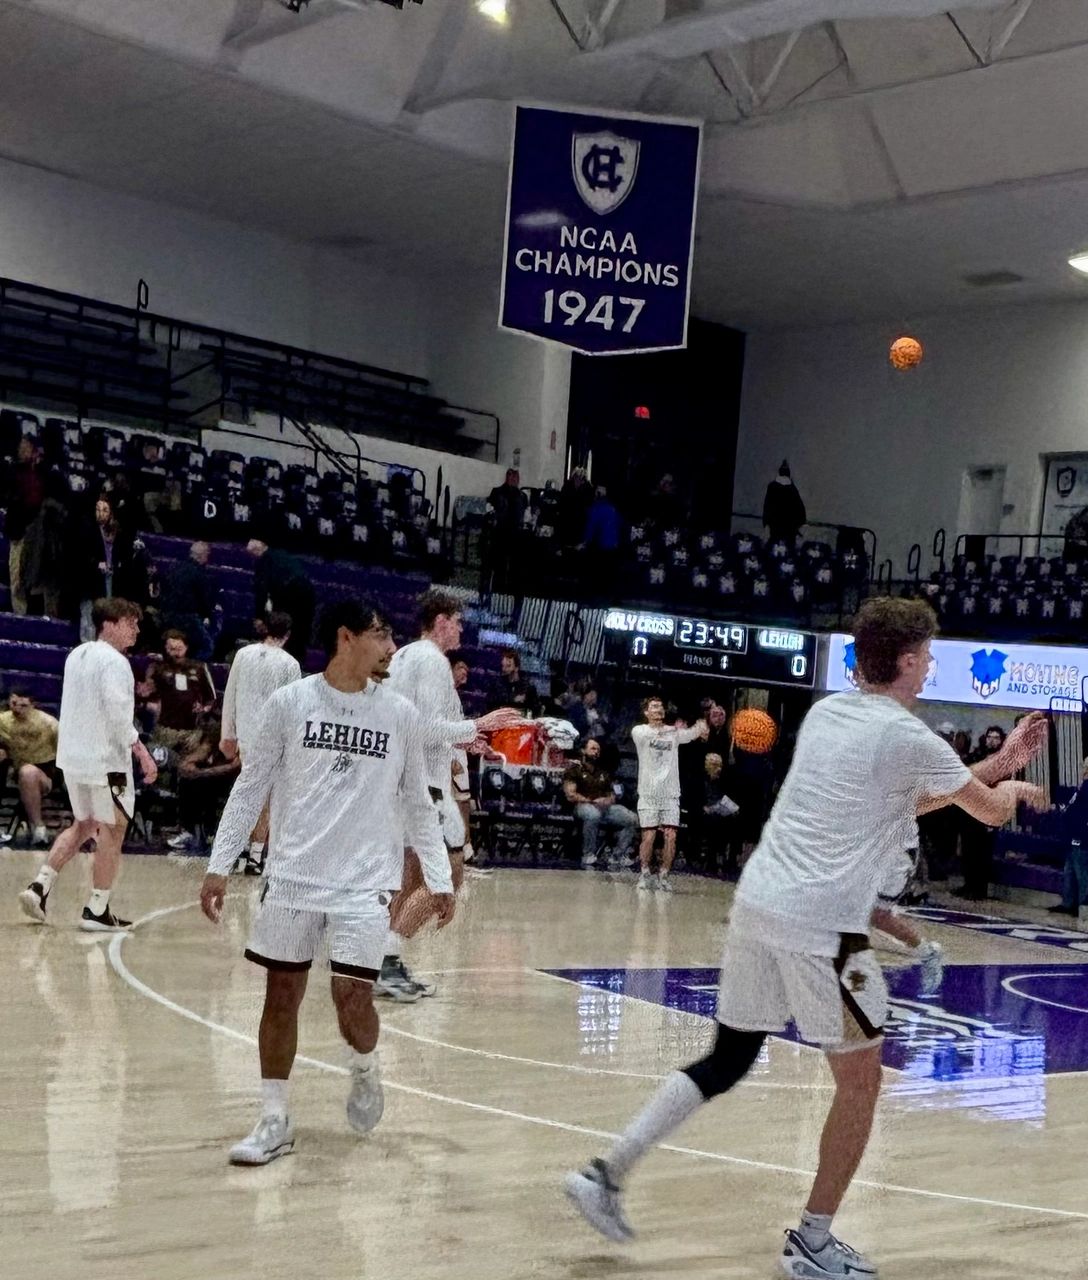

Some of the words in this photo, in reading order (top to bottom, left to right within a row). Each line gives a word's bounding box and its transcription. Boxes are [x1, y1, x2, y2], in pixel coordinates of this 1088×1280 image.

[560, 225, 638, 254] NCAA
[515, 248, 679, 287] CHAMPIONS
[544, 289, 646, 333] 1947
[680, 619, 744, 648] 23:49
[791, 654, 807, 677] 0
[1006, 683, 1029, 694] AND
[303, 721, 390, 754] LEHIGH
